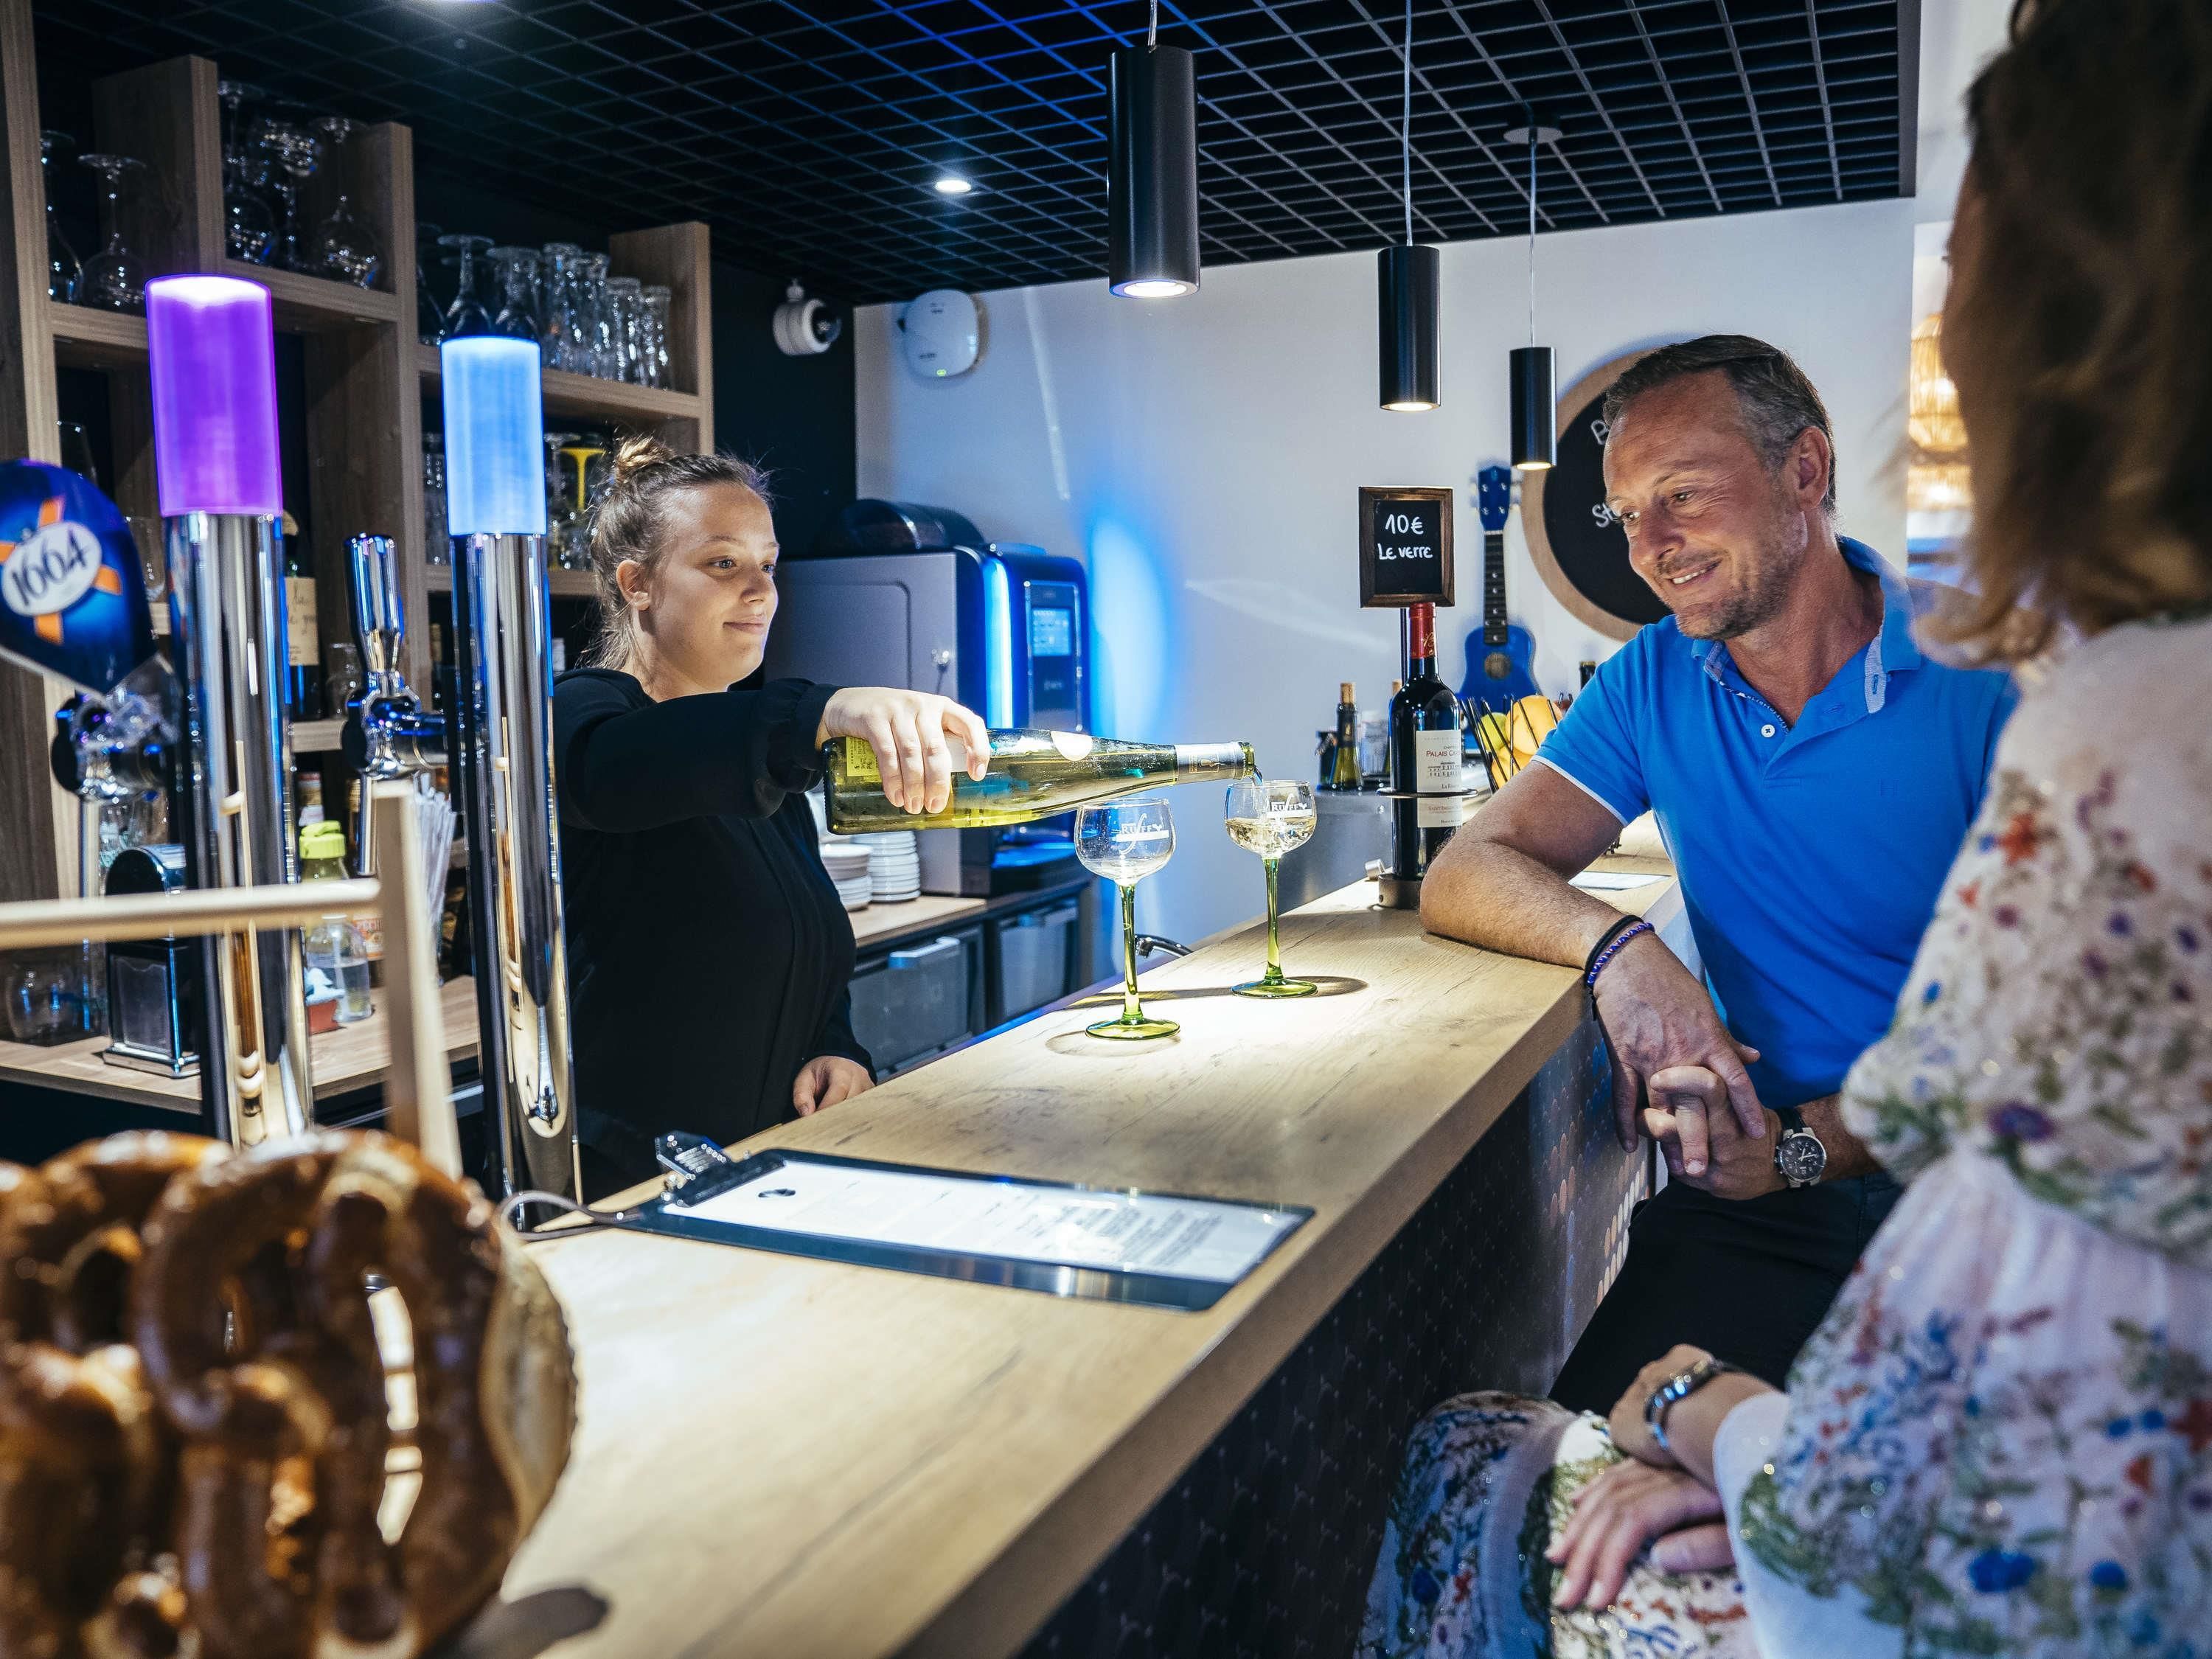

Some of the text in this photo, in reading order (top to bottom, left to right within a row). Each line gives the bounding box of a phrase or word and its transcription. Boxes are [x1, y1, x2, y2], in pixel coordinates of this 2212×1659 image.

[1385, 513, 1425, 535] 10€
[1398, 546, 1433, 559] verre
[11, 528, 91, 608] 1664
[1425, 750, 1447, 758] PALAIS
